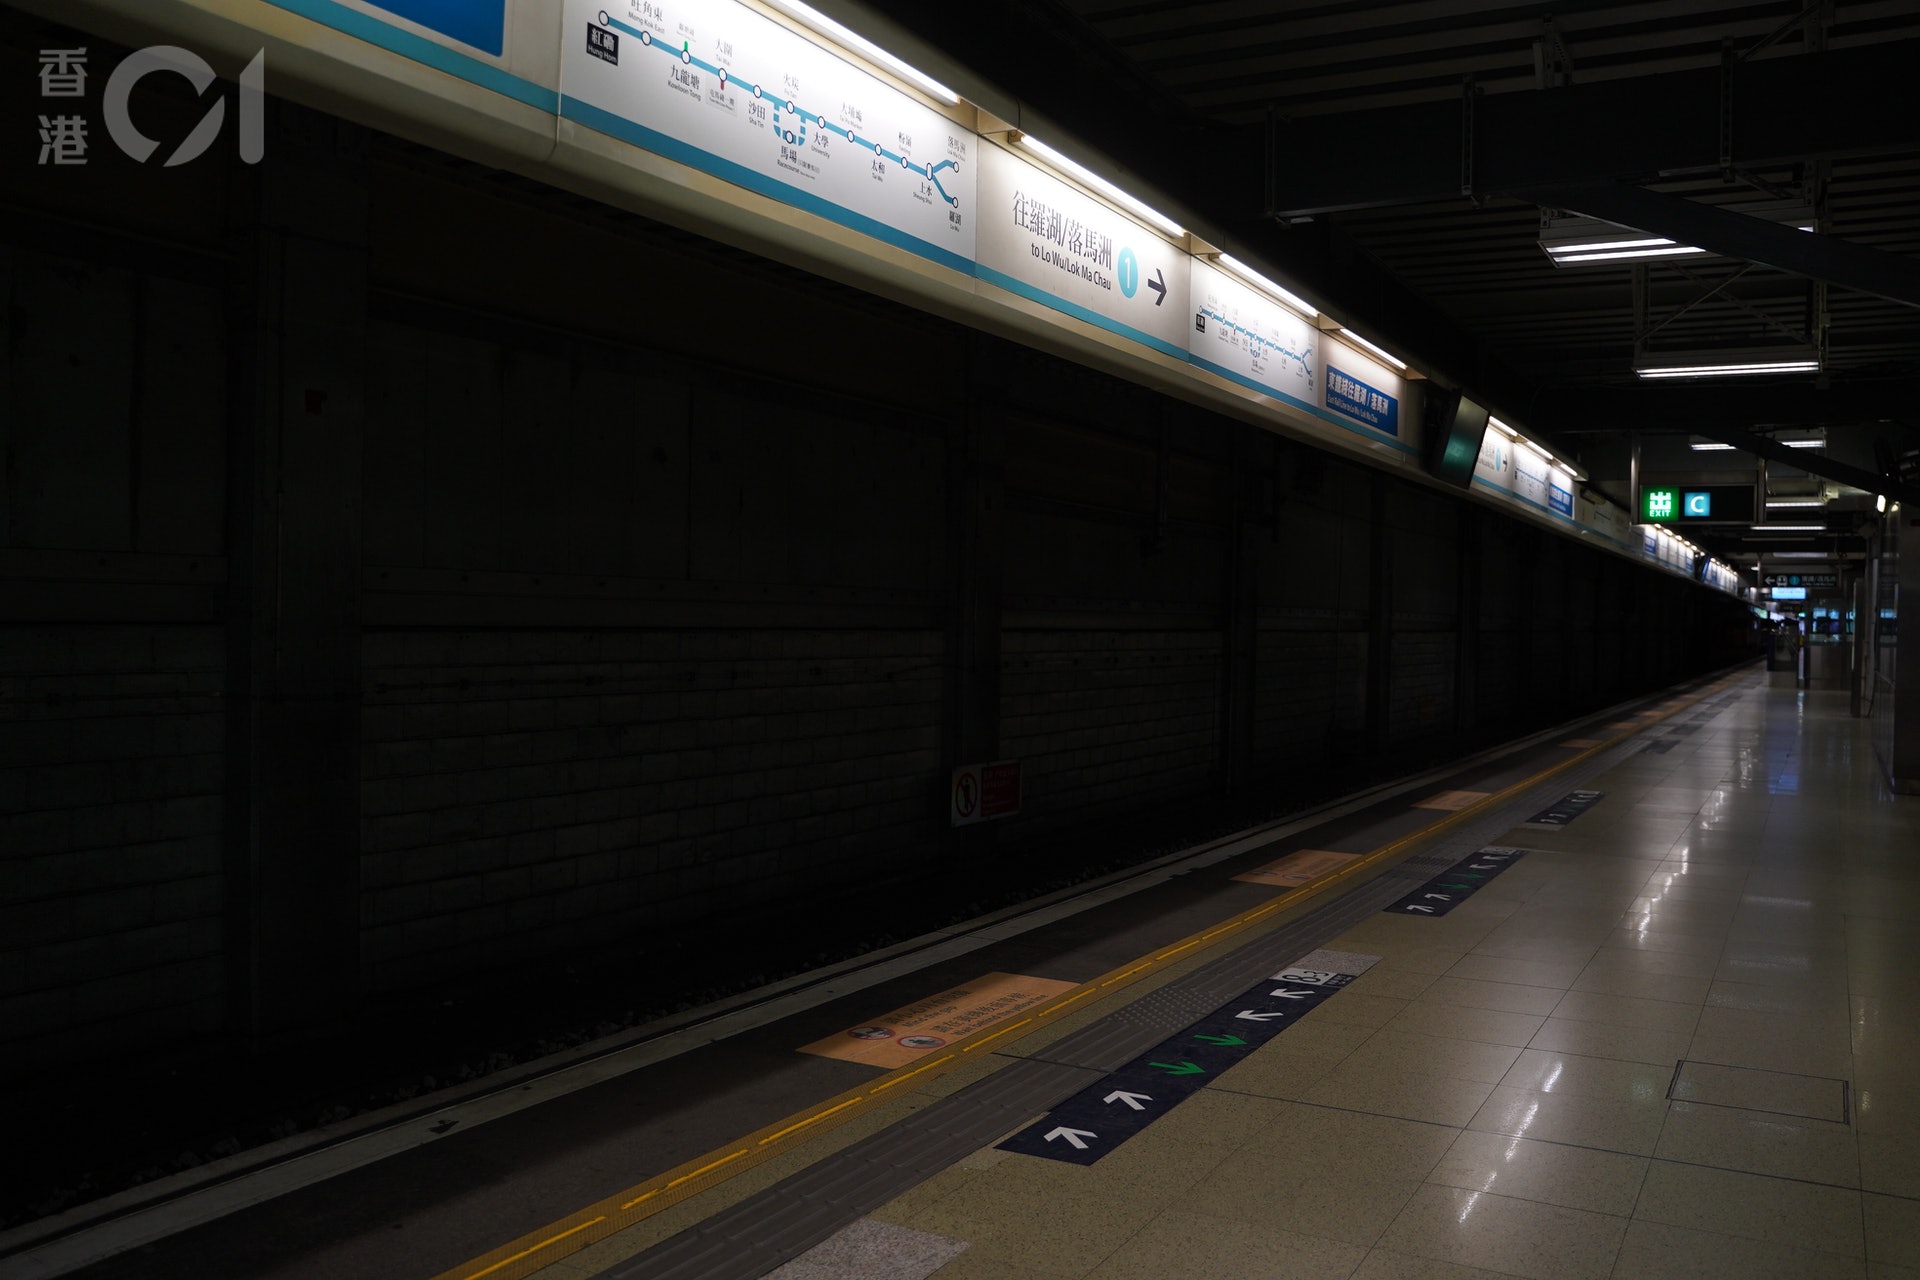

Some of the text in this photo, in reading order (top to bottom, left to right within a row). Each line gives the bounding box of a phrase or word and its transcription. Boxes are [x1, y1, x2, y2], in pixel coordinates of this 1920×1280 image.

[628, 11, 643, 24] Mong
[588, 45, 617, 62] Hung Hom
[670, 64, 700, 90] 九龍塘
[668, 80, 701, 102] Kowloon Tong
[748, 100, 766, 120] 沙田
[781, 145, 797, 164] 馬場
[1013, 190, 1112, 271] 往羅湖/落馬洲
[1031, 242, 1040, 257] to
[1041, 245, 1051, 263] Lo
[1081, 264, 1093, 281] Ma
[1093, 271, 1111, 290] Chau
[1690, 496, 1705, 513] C
